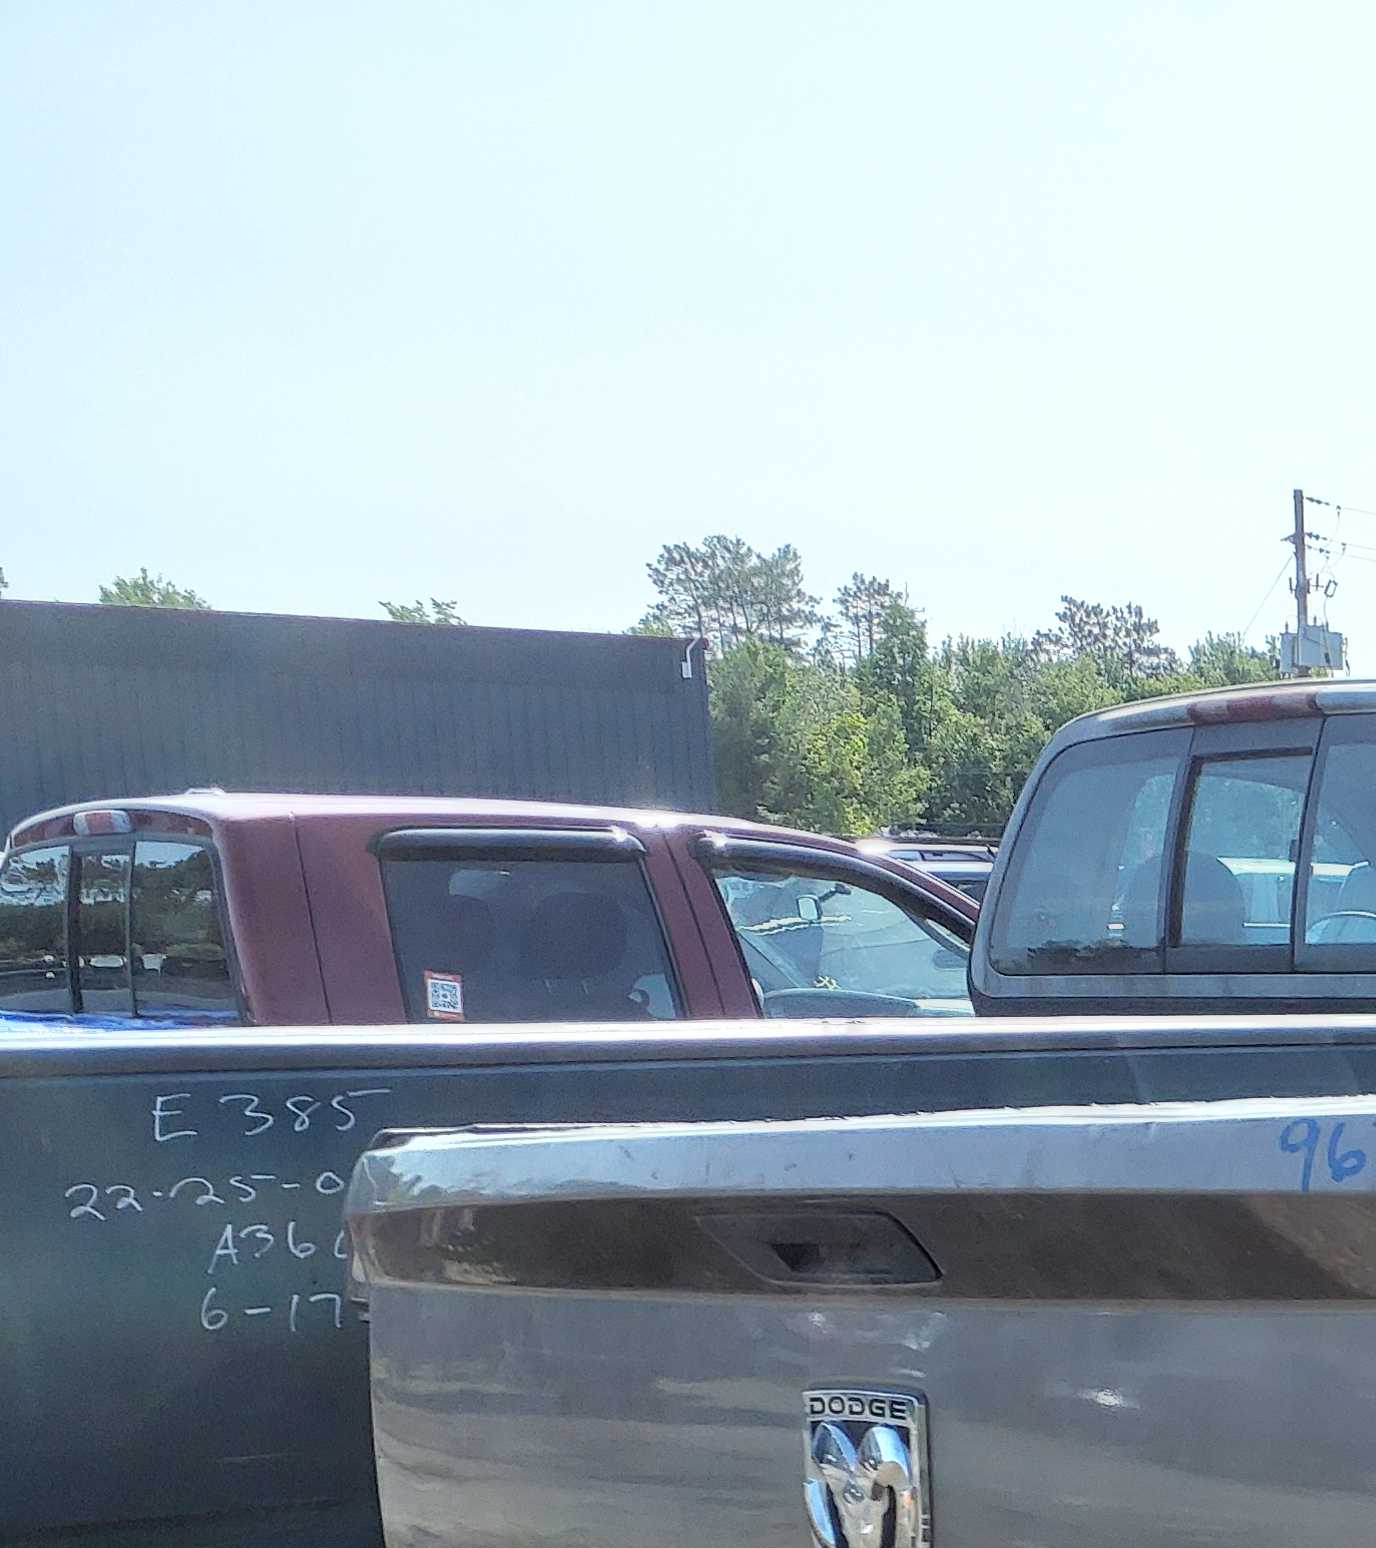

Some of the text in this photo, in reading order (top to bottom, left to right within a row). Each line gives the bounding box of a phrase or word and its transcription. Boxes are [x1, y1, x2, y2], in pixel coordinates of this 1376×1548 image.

[152, 1088, 392, 1143] E 385
[808, 1396, 908, 1422] DODGE
